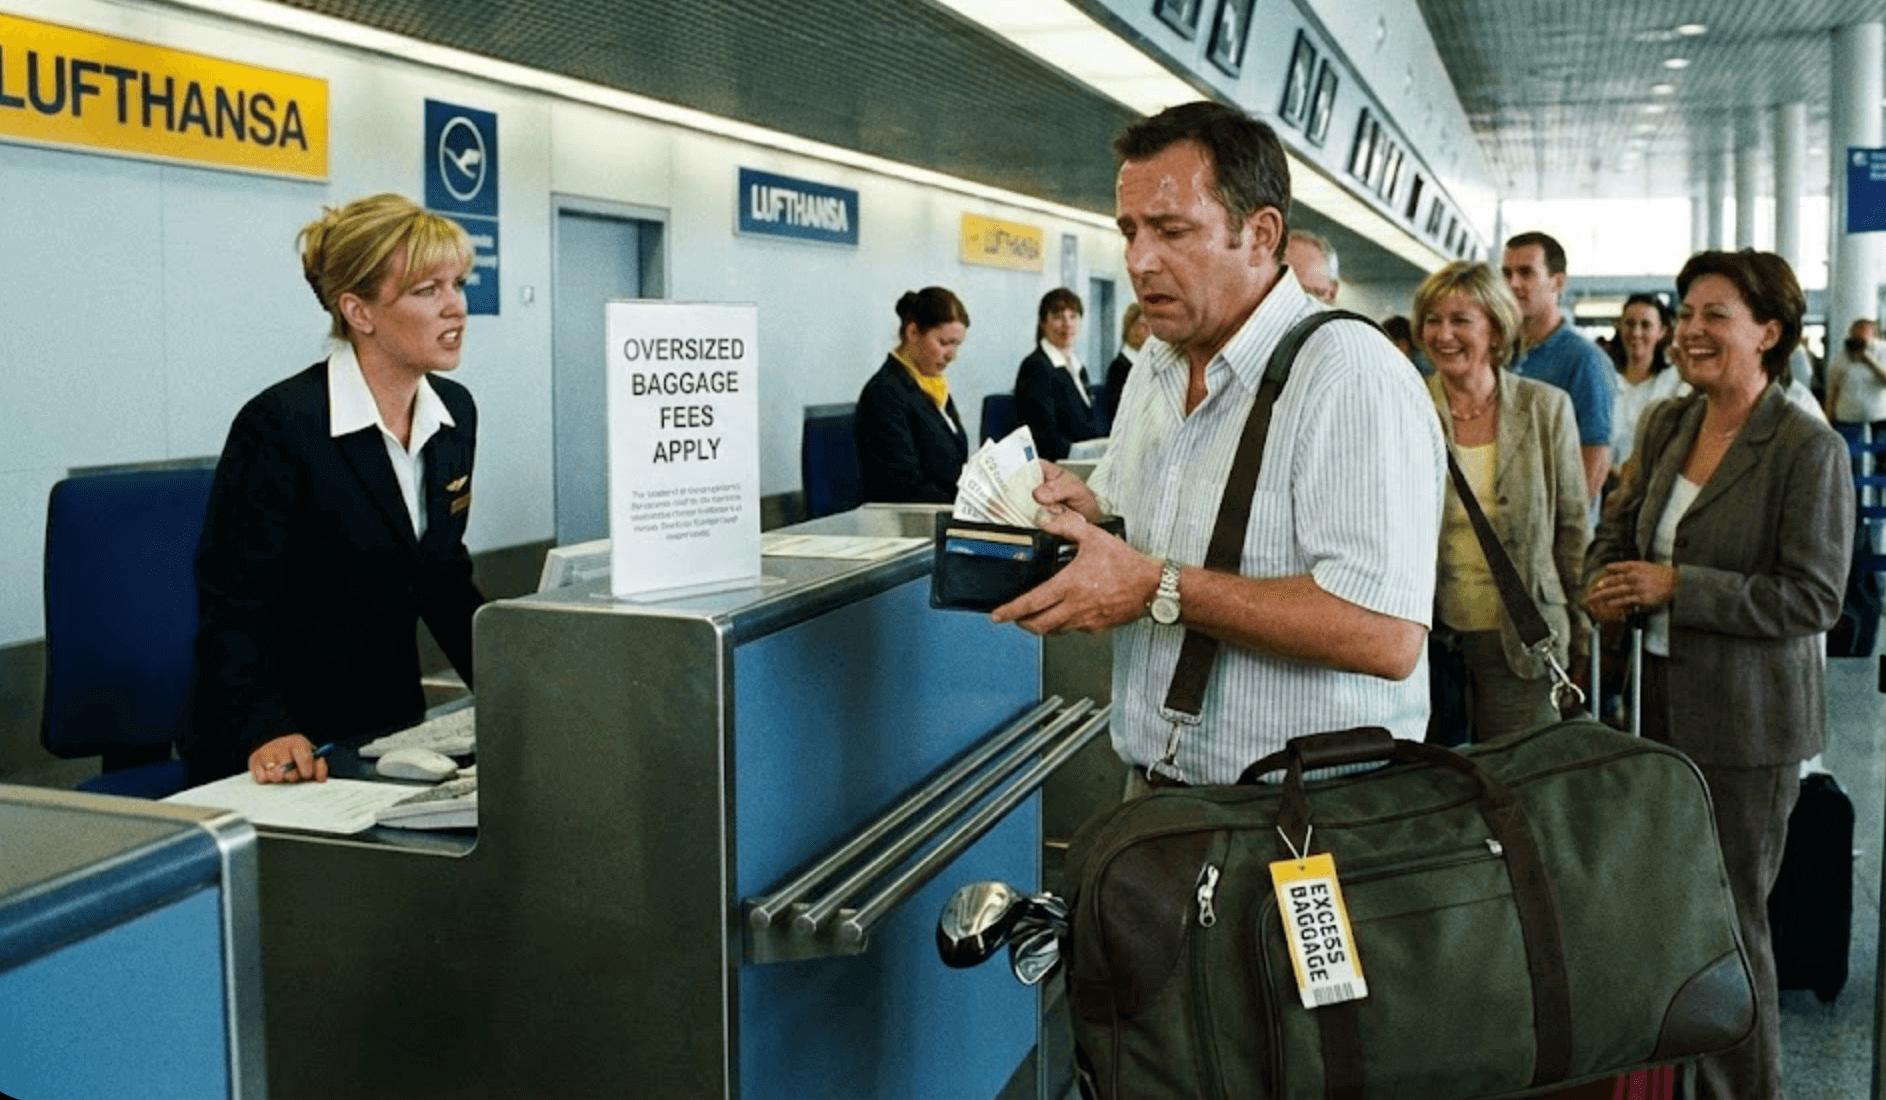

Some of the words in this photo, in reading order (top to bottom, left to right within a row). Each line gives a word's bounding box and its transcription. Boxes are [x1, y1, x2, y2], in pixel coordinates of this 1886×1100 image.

[0, 45, 308, 151] LUFTHANSA
[751, 184, 848, 233] LUFTHANSA
[623, 338, 745, 362] OVERSIZED
[631, 371, 739, 396] BAGGAGE
[660, 405, 714, 429] FEES
[653, 437, 721, 463] APPLY
[1290, 886, 1328, 982] BAGGAGE
[1310, 884, 1345, 964] EXCESS
